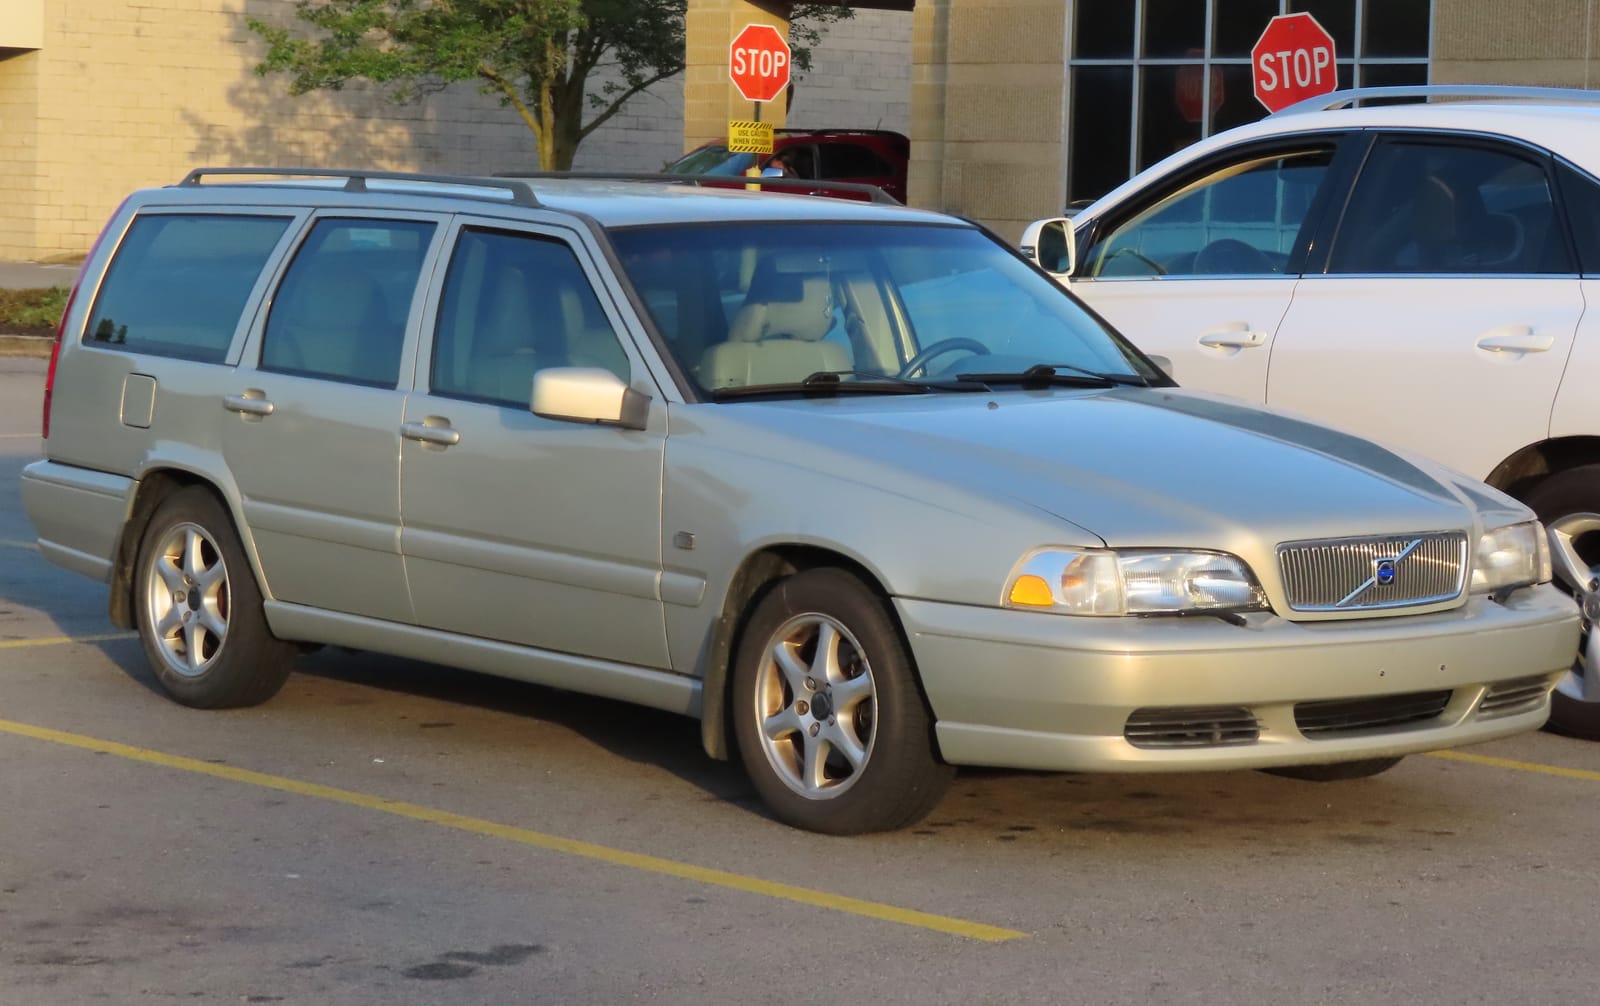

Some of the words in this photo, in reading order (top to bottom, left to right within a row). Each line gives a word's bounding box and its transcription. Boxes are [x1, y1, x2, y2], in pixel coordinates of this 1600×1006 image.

[733, 47, 787, 78] STOP
[1259, 46, 1330, 91] STOP
[737, 129, 750, 137] USE
